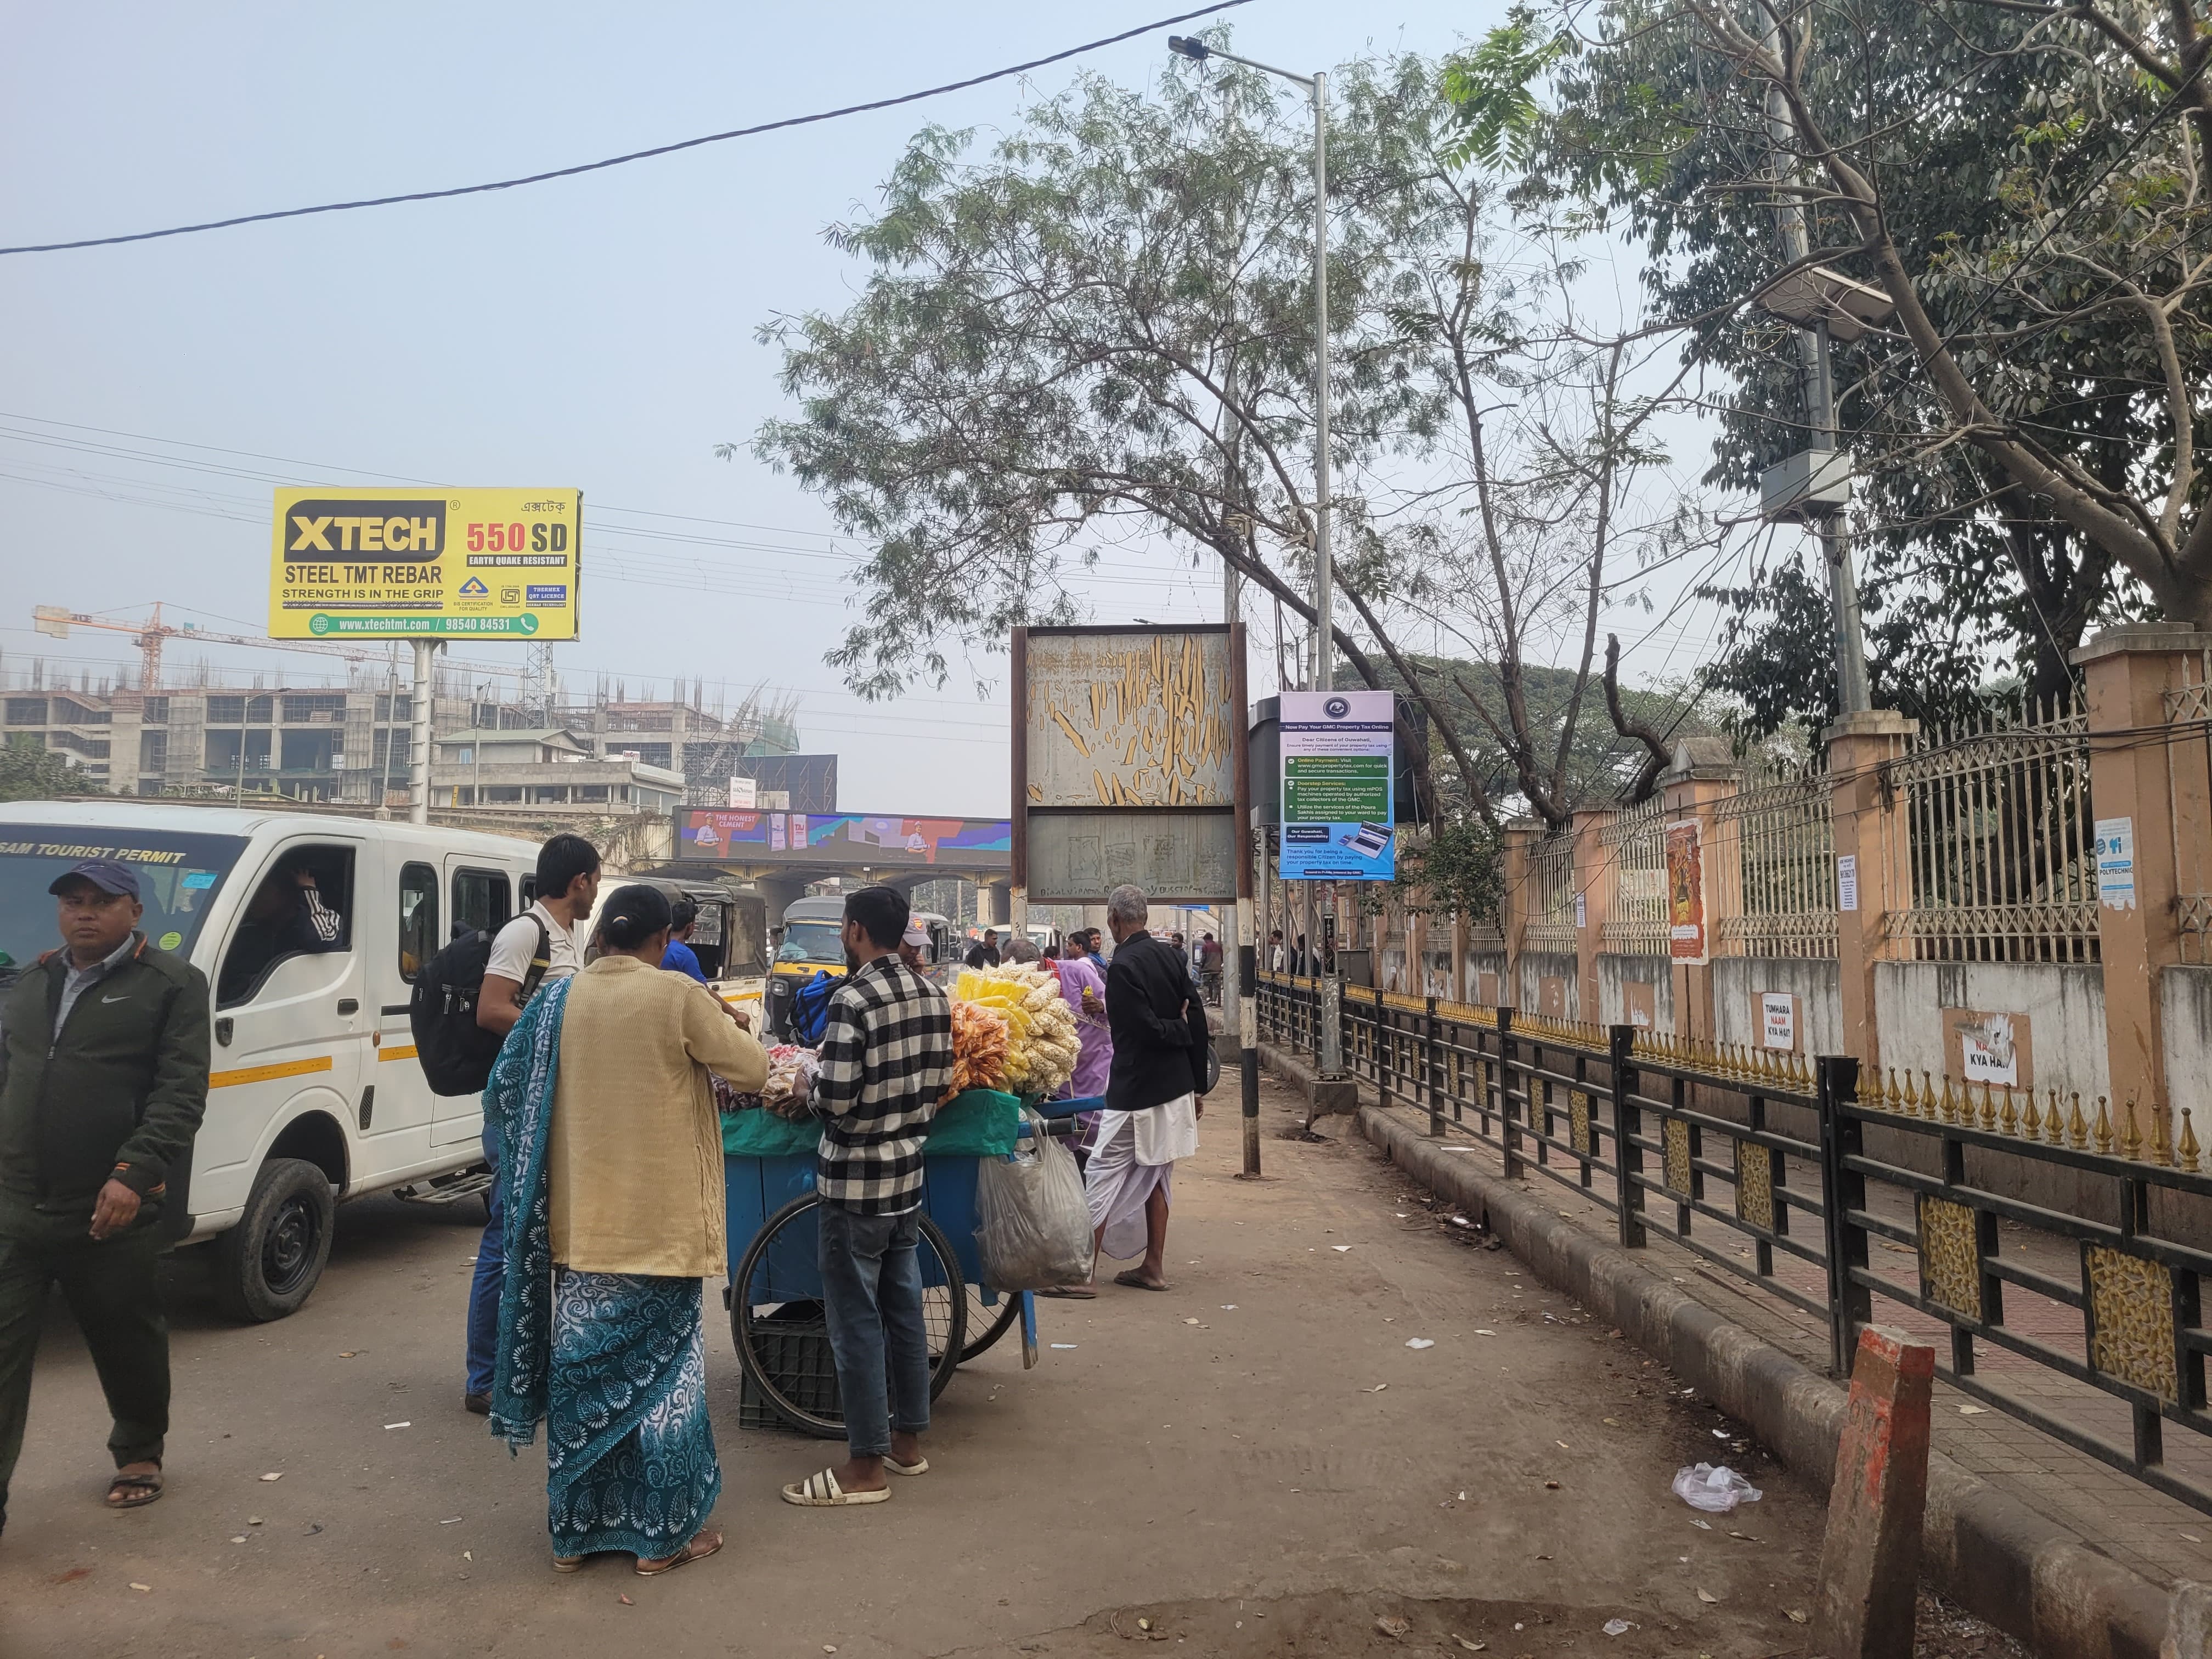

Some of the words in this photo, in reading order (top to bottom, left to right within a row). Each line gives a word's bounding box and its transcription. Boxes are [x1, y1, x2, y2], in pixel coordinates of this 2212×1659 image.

[290, 516, 437, 551] XTECH
[467, 523, 525, 552] 550
[532, 523, 567, 552] SD
[469, 557, 494, 565] EARTH
[496, 557, 521, 565] QUAKE
[523, 557, 565, 565] RESISTANT
[285, 566, 338, 584] STEEL
[343, 566, 378, 584] TMT
[383, 566, 442, 584] REBAR
[283, 589, 351, 598] STRENGTH
[354, 589, 365, 598] IS
[369, 589, 381, 598] IN
[385, 589, 410, 598] THE
[413, 589, 444, 599] GRIP
[339, 618, 430, 630] www.xtechtmt.com
[446, 618, 476, 630] 98540
[480, 618, 510, 630] 84531
[36, 844, 115, 859] TOURIST
[114, 849, 187, 864] PERMIT
[2100, 867, 2133, 876] POLYTECHNIC
[1765, 1004, 1790, 1014] TUMHARA
[1771, 1015, 1786, 1026] NAAM
[1768, 1026, 1778, 1036] KYA
[1779, 1028, 1790, 1038] HAI?
[1976, 1040, 1988, 1051] NA
[1970, 1053, 1988, 1066] KYA
